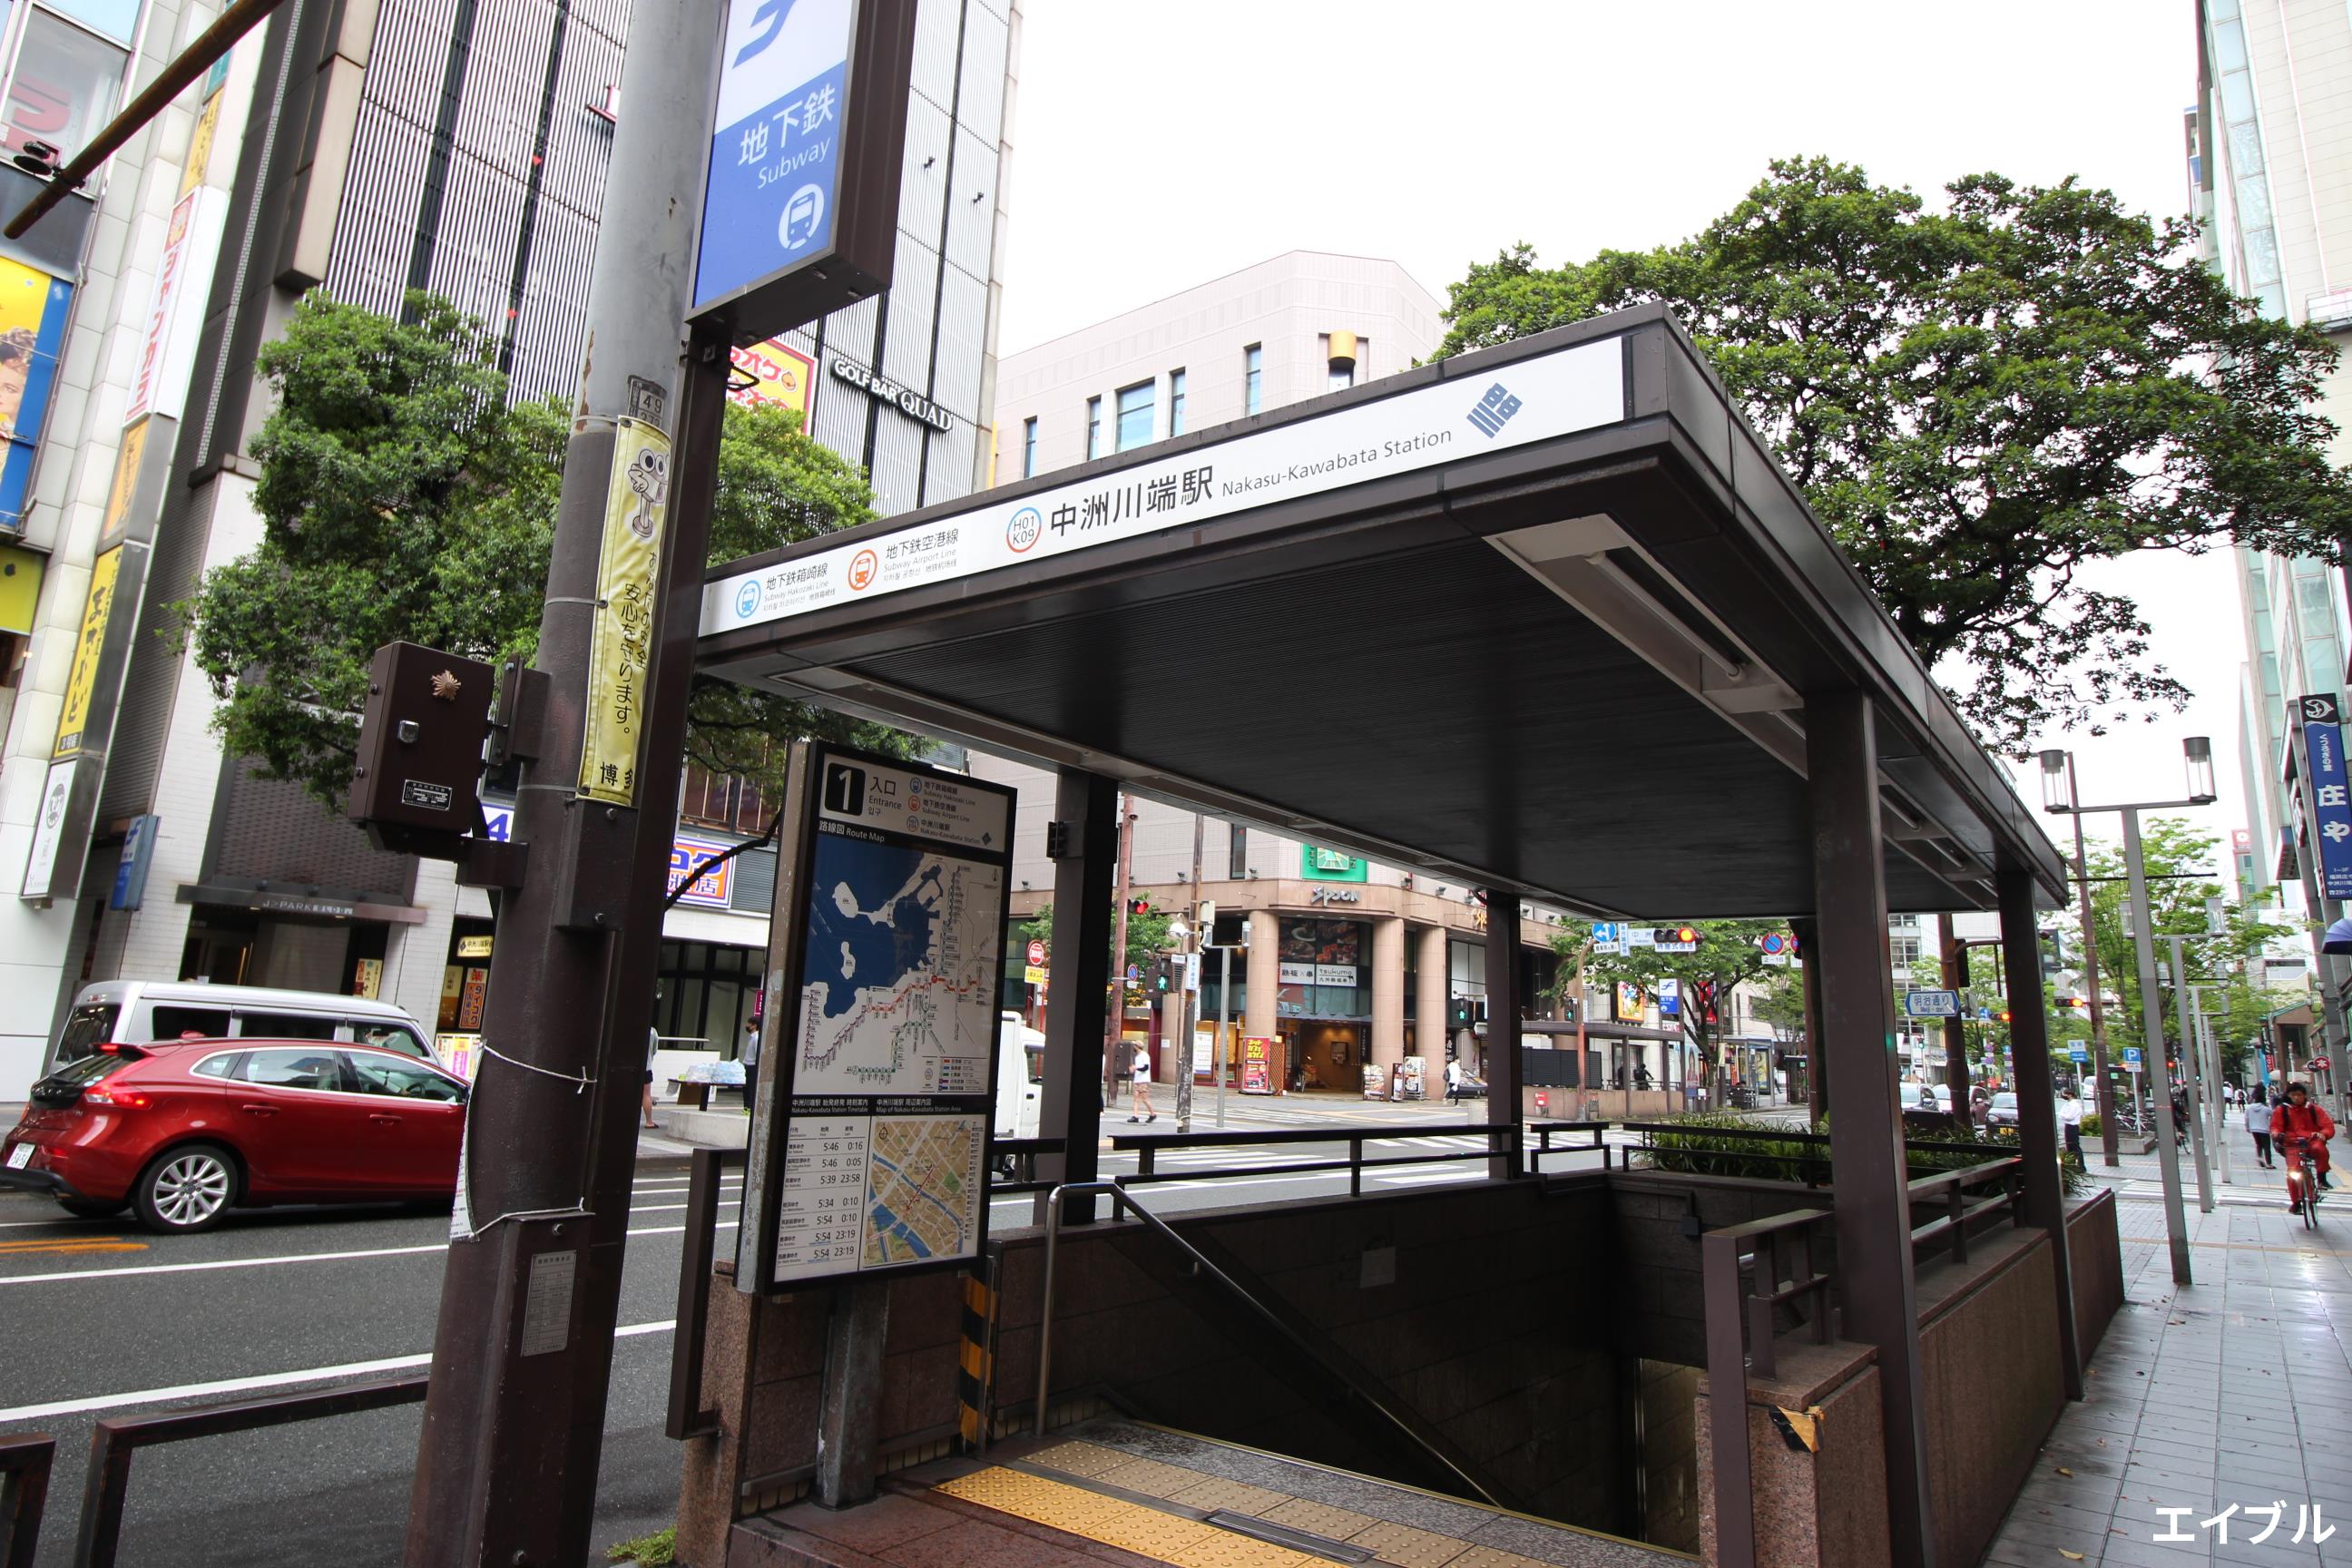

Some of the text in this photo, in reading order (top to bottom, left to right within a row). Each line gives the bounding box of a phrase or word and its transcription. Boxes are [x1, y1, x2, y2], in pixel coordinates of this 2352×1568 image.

[738, 83, 836, 166] 地下鉄
[758, 137, 830, 190] Subway
[835, 359, 952, 430] GOLF BAR QUAD
[643, 395, 662, 414] 49
[1222, 430, 1452, 496] Nakasu-Kawabata Station
[1051, 466, 1213, 536] 中洲川端駅
[1014, 515, 1034, 532] H01
[886, 527, 960, 560] 地下鉄空港線
[1014, 529, 1034, 544] K09
[884, 547, 957, 573] Subway Airport Line
[766, 562, 829, 591] 地下鉄箱崎線
[838, 769, 852, 811] 1
[869, 776, 896, 796] 入口
[868, 795, 902, 810] Entrance
[2318, 785, 2350, 843] 庄や
[818, 820, 845, 835] 路線図
[846, 828, 885, 843] Route Map
[823, 1142, 839, 1152] 5:46
[848, 1141, 863, 1151] 0:16
[821, 1159, 838, 1168] 5:46
[846, 1157, 862, 1167] 0:05
[820, 1175, 837, 1184] 5:39
[840, 1173, 860, 1183] 23:58
[818, 1199, 834, 1209] 5:34
[842, 1196, 858, 1206] 0:10
[817, 1215, 833, 1225] 5:54
[841, 1213, 858, 1222] 0:10
[815, 1231, 831, 1241] 5:54
[836, 1229, 856, 1240] 23:19
[813, 1249, 829, 1259] 5:54
[834, 1245, 854, 1256] 23:19
